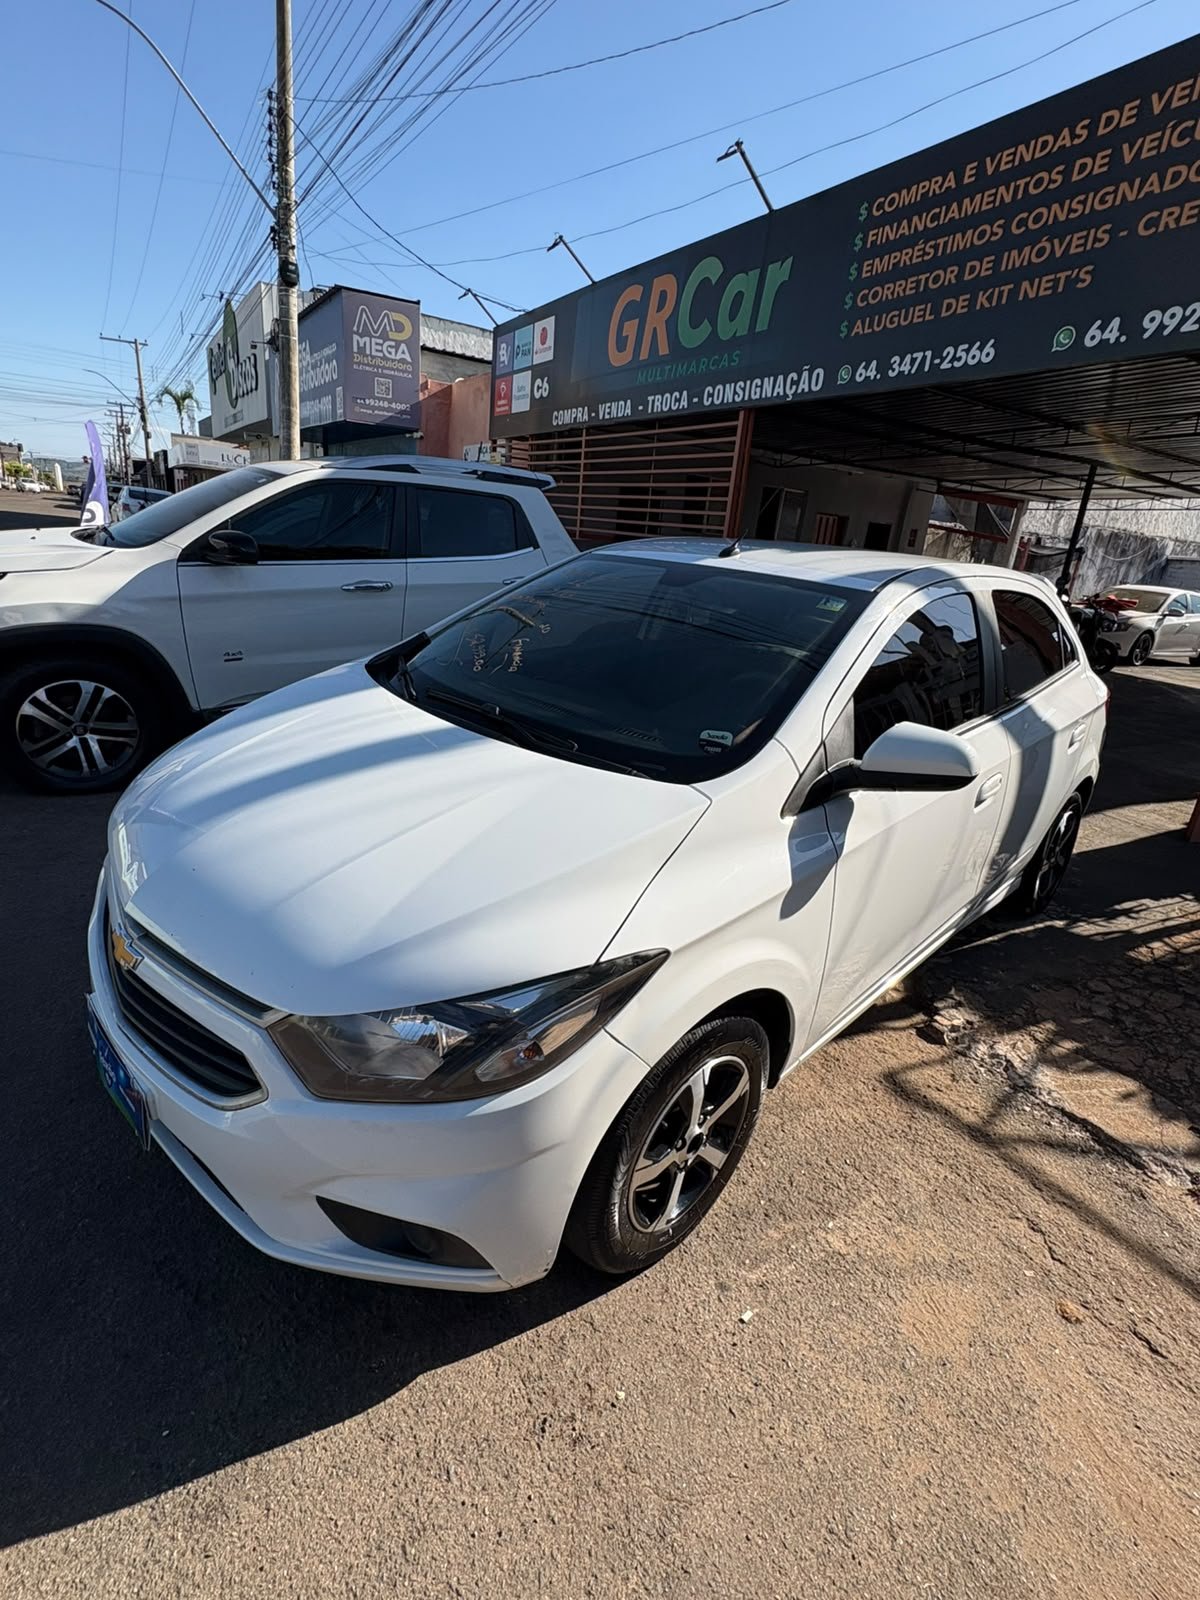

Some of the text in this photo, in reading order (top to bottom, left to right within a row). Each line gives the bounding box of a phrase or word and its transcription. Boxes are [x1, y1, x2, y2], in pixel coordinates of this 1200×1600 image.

[872, 170, 956, 217] COMPRA
[963, 161, 979, 186] E
[985, 118, 1091, 176] VENDAS
[1097, 99, 1141, 136] DE
[866, 165, 1065, 249] FINANCIAMENTOS
[1071, 149, 1112, 183] DE
[856, 267, 957, 307] CORRETOR
[963, 255, 995, 285] DE
[1000, 223, 1113, 272] IMÓVEIS
[861, 219, 1005, 279] EMPRÉSTIMOS
[850, 304, 934, 337] ALUGUEL
[940, 293, 970, 316] DE
[975, 284, 1014, 309] KIT
[1018, 265, 1095, 302] NET'S
[353, 334, 412, 363] MEGA
[1083, 316, 1127, 348] 64.
[353, 354, 413, 372] Distribuidora
[636, 349, 742, 386] MULTIMARCAS
[855, 338, 996, 382] 64. 3471-2566
[534, 377, 549, 399] C6
[552, 405, 589, 426] COMPRA
[598, 398, 632, 420] VENDA
[647, 393, 688, 414] TROCA
[703, 365, 825, 406] CONSIGNAÇÃO
